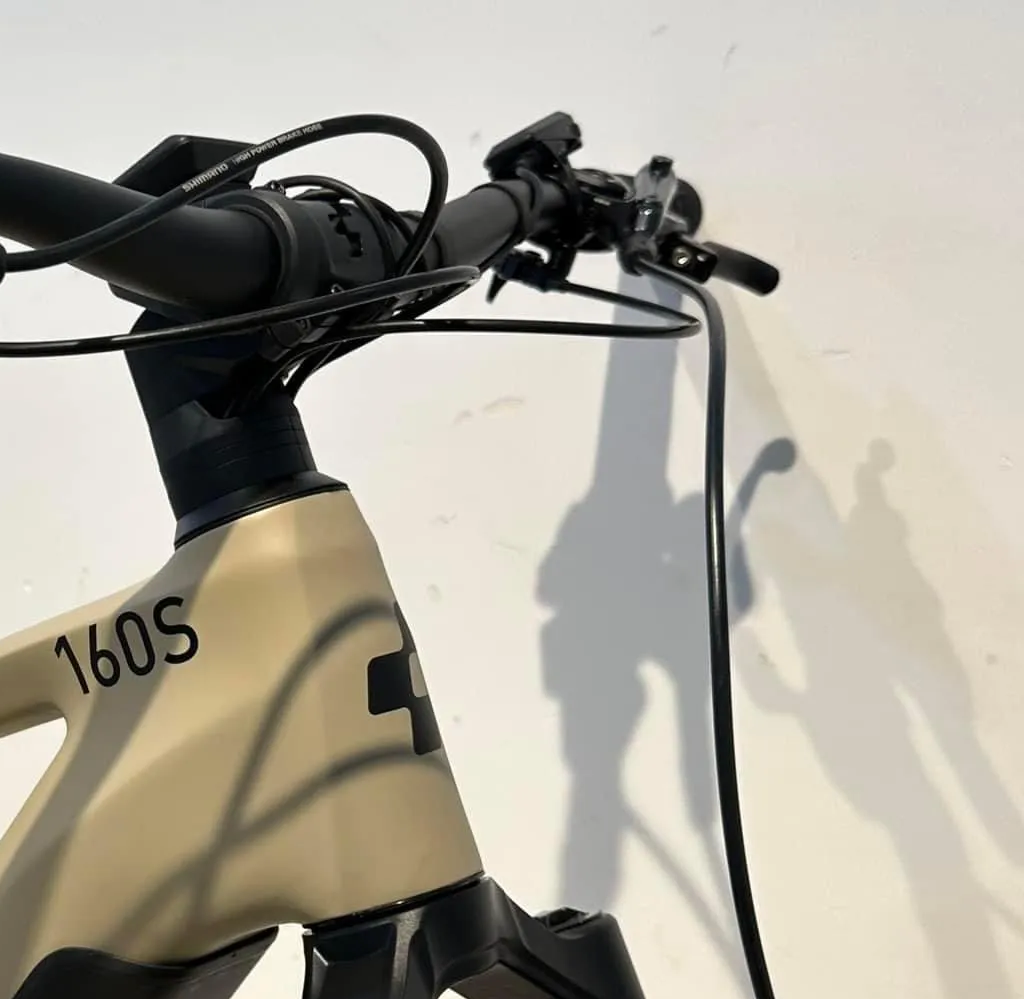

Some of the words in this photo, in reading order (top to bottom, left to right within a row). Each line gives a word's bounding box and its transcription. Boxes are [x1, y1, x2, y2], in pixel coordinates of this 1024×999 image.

[182, 162, 229, 193] SHIMANO
[250, 138, 278, 157] POWER
[54, 596, 199, 695] 160S
